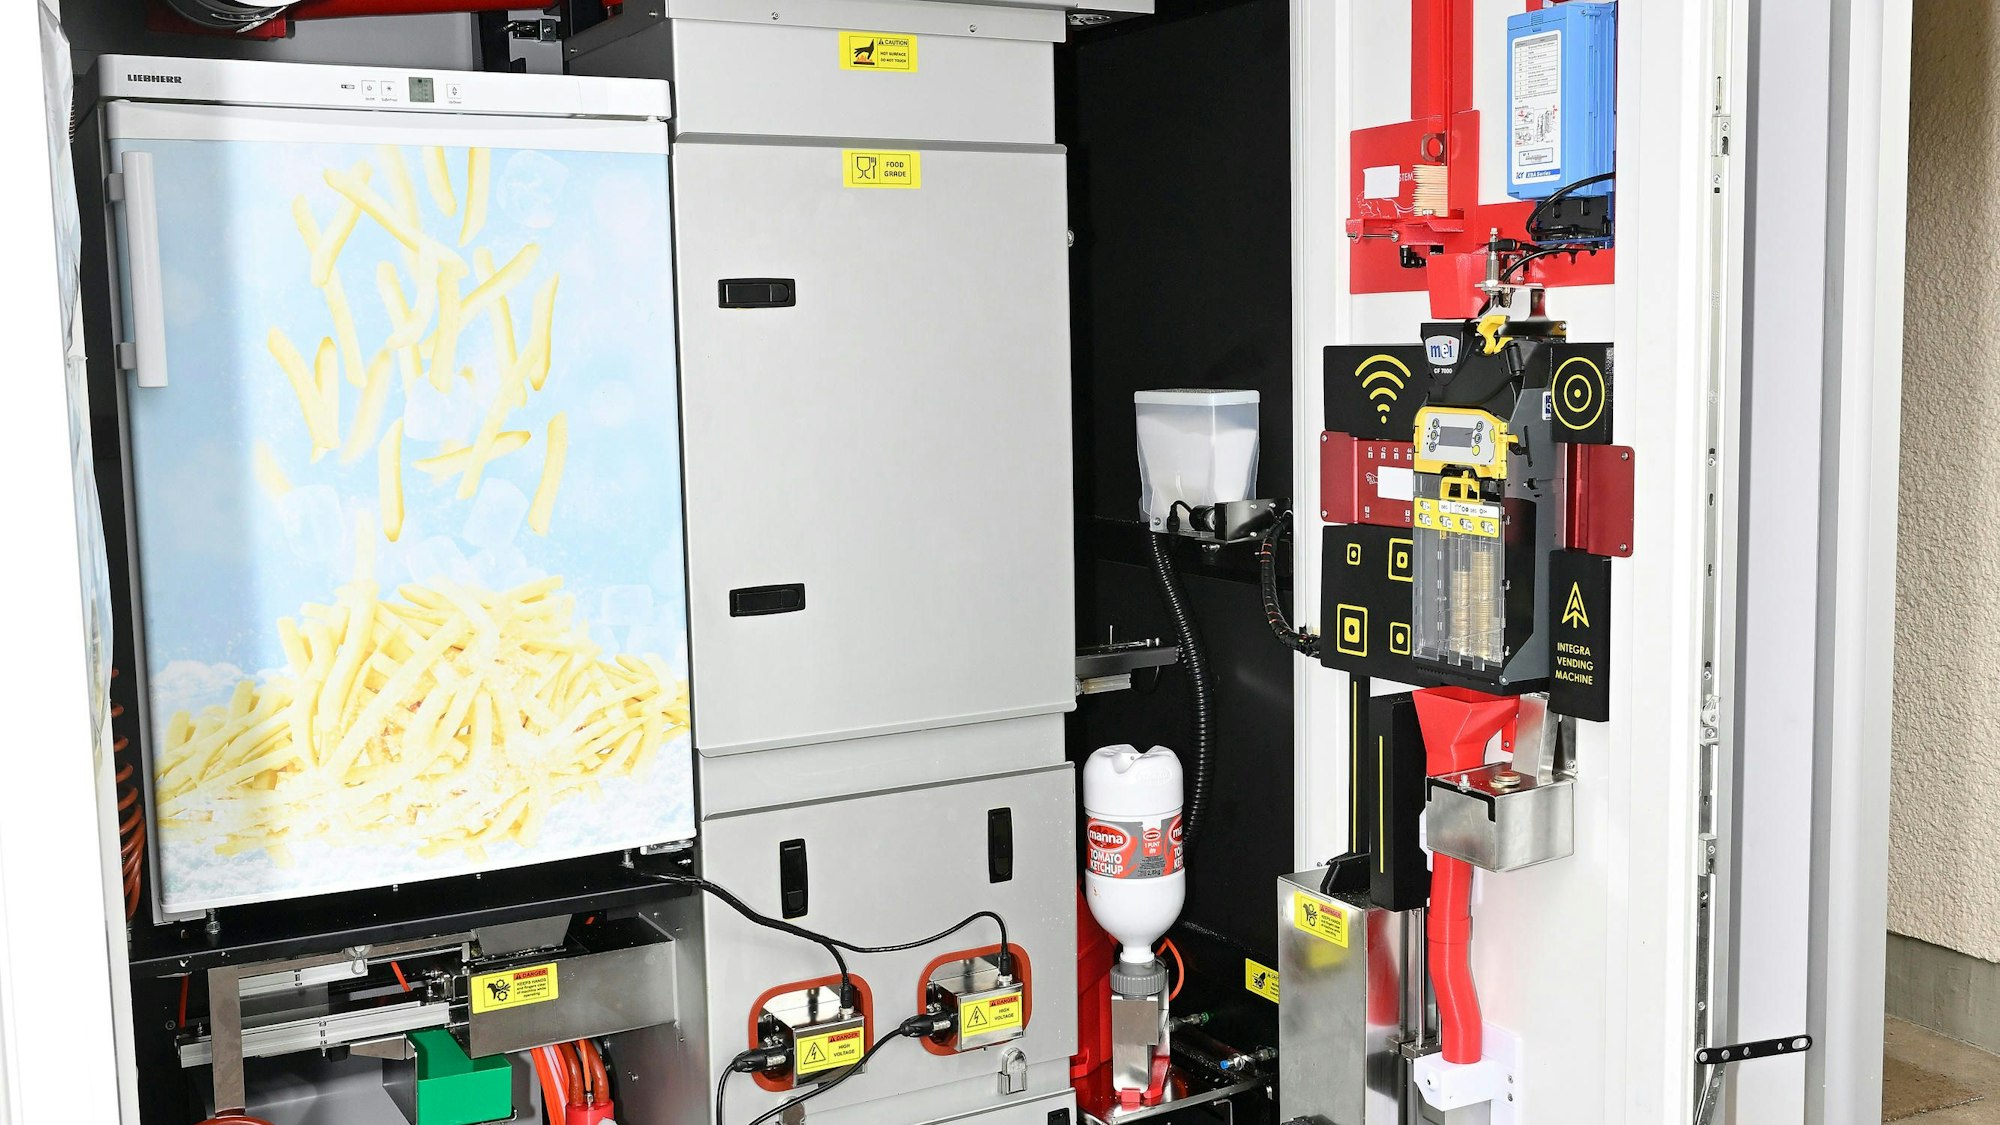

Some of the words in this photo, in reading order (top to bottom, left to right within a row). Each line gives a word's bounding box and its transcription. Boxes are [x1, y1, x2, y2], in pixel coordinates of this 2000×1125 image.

[127, 74, 182, 83] LIEBHERR
[1430, 340, 1452, 359] mei
[1556, 642, 1591, 657] INTEGRA
[1556, 656, 1594, 671] VENDING
[1554, 669, 1593, 685] MACHINE
[1089, 829, 1124, 845] manna
[1090, 848, 1123, 864] TOMATO
[1090, 859, 1124, 875] KETCHUP
[522, 970, 546, 978] DANGER
[837, 1033, 858, 1041] DANGER
[833, 1049, 855, 1057] VOLTAGE
